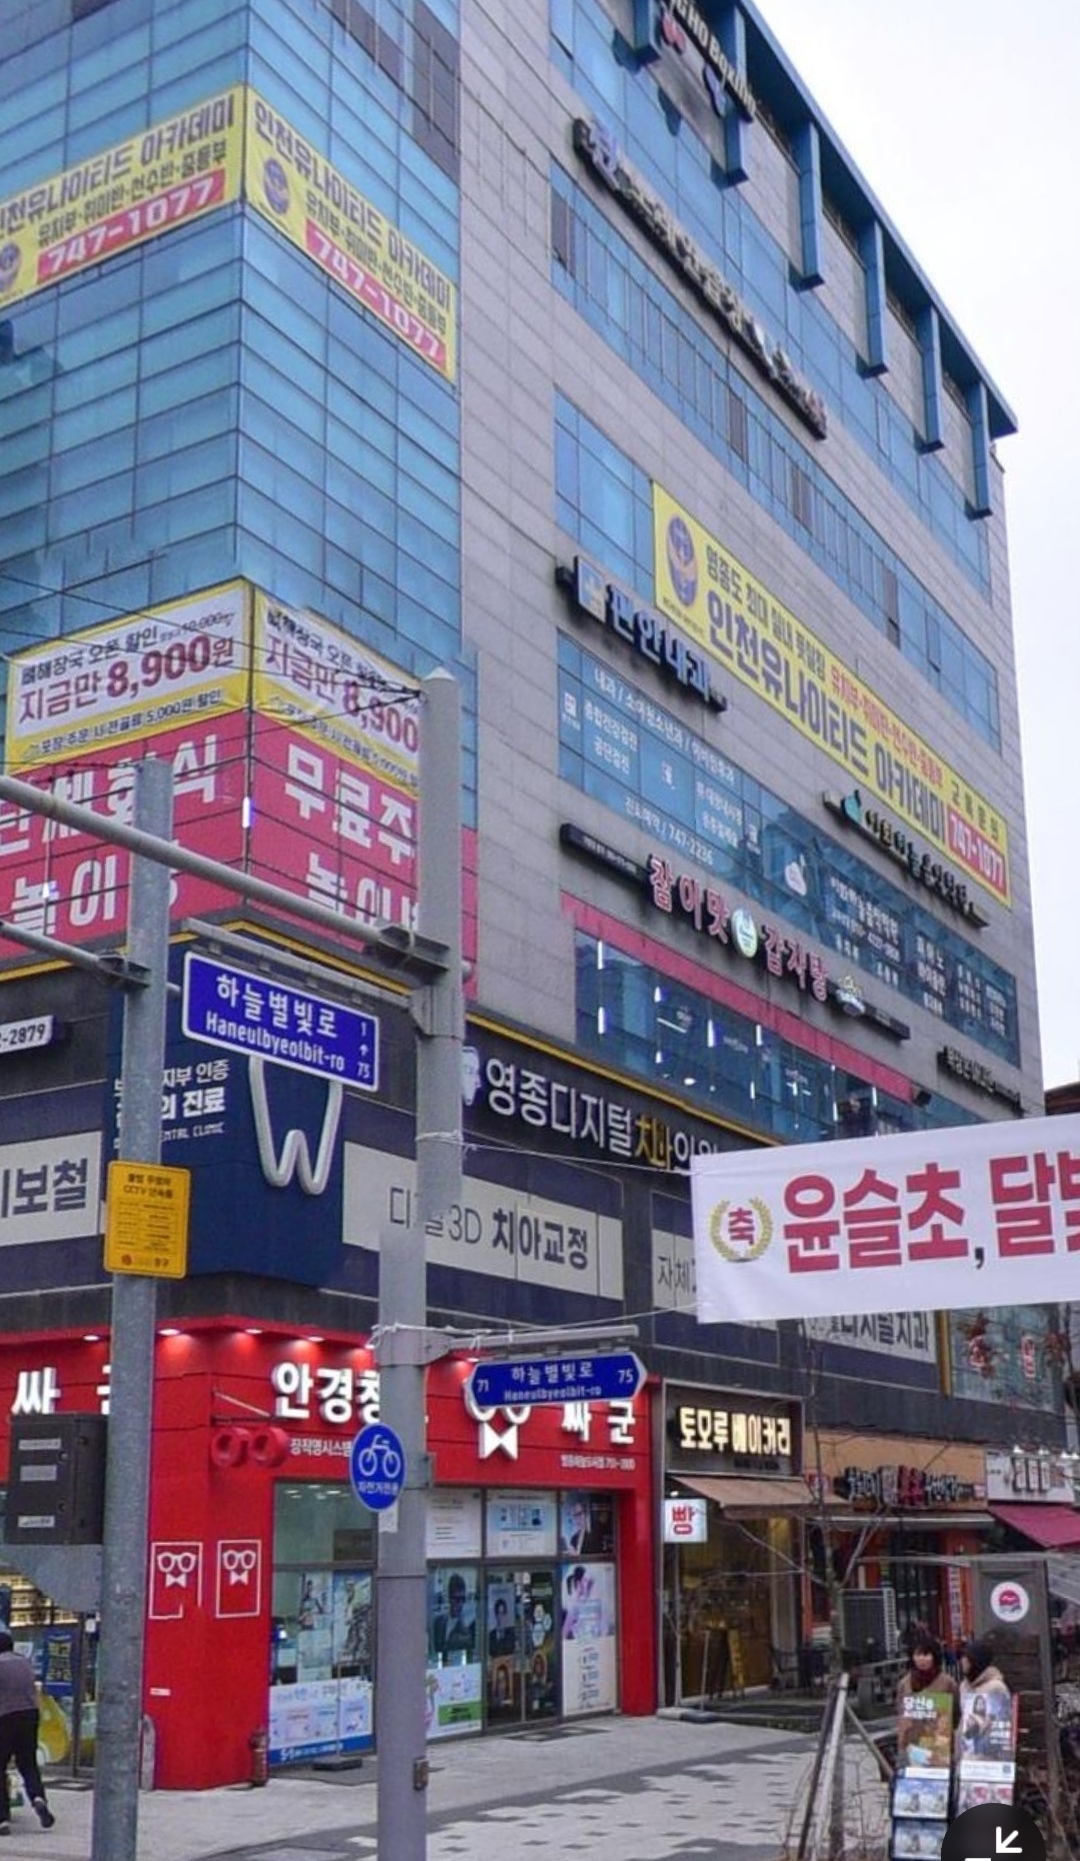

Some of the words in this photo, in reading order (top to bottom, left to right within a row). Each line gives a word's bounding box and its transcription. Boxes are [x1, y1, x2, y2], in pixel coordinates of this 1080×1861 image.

[140, 94, 234, 167] 아카데미
[254, 100, 382, 248] 인천유나이티드
[48, 177, 215, 272] 747-1077
[314, 230, 438, 358] 747-1077
[18, 670, 103, 725] 지금만
[106, 634, 234, 699] 8,900원
[265, 633, 337, 706] 지금만
[707, 588, 870, 778] 인천유나이티드
[759, 924, 830, 1003] 감자탕
[0, 1023, 46, 1048] -2879
[216, 973, 338, 1039] 하늘별빛로
[195, 1059, 230, 1084] 인증
[205, 1010, 345, 1072] Haneulbyeolbit-ro
[357, 1061, 371, 1079] 75
[182, 1086, 226, 1118] 진료
[492, 1206, 588, 1271] 치아교정
[728, 1207, 756, 1246] 축
[783, 1161, 986, 1274] 윤슬초,
[656, 1256, 697, 1297] 자체
[477, 1379, 489, 1393] 71
[511, 1361, 594, 1386] 하늘별빛로
[618, 1368, 635, 1384] 75
[671, 1505, 696, 1535] 빵
